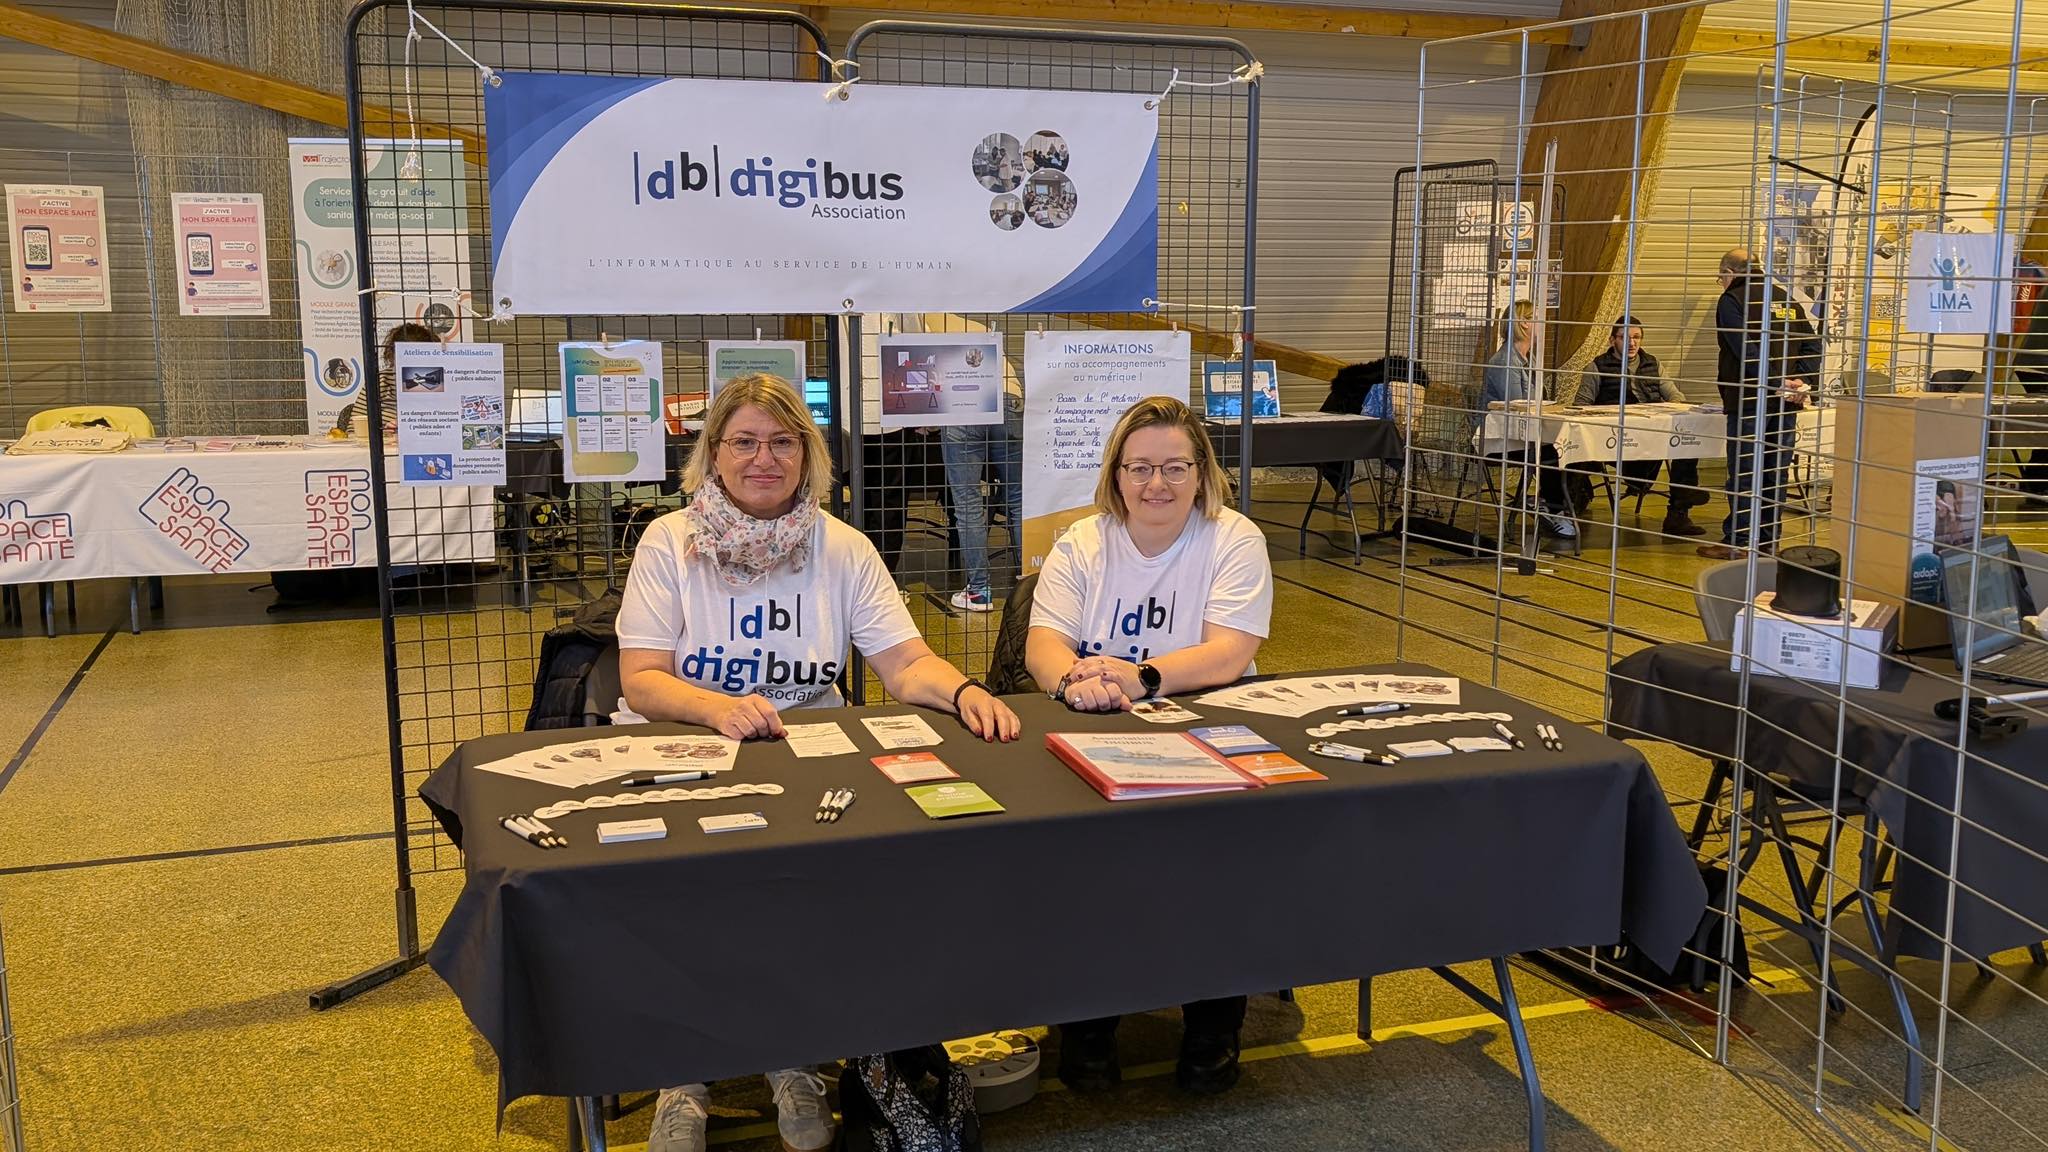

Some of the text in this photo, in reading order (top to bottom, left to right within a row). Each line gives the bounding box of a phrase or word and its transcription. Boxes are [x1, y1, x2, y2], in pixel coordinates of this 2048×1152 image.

[730, 156, 905, 208] digibus
[39, 208, 69, 216] ESPACE
[71, 209, 97, 217] SANTÉ
[231, 215, 257, 224] SANTÉ
[811, 202, 906, 220] Association
[588, 258, 953, 270] L'INFORMATIQUE AU SERVICE DE L'HUMAIN
[1929, 292, 1973, 311] LIMA
[441, 349, 494, 357] Sensibilisation
[1064, 343, 1154, 355] INFORMATIONS
[1047, 359, 1167, 370] sur nos accompagnements
[1073, 374, 1085, 382] au
[1087, 371, 1137, 384] numérique
[1083, 392, 1093, 403] de
[158, 484, 244, 558] ESPACE
[327, 474, 350, 567] ESPACE
[305, 493, 330, 569] SANTÉ
[0, 538, 75, 563] ANTÉ
[158, 515, 230, 574] SANTÉ
[682, 645, 838, 692] digibus
